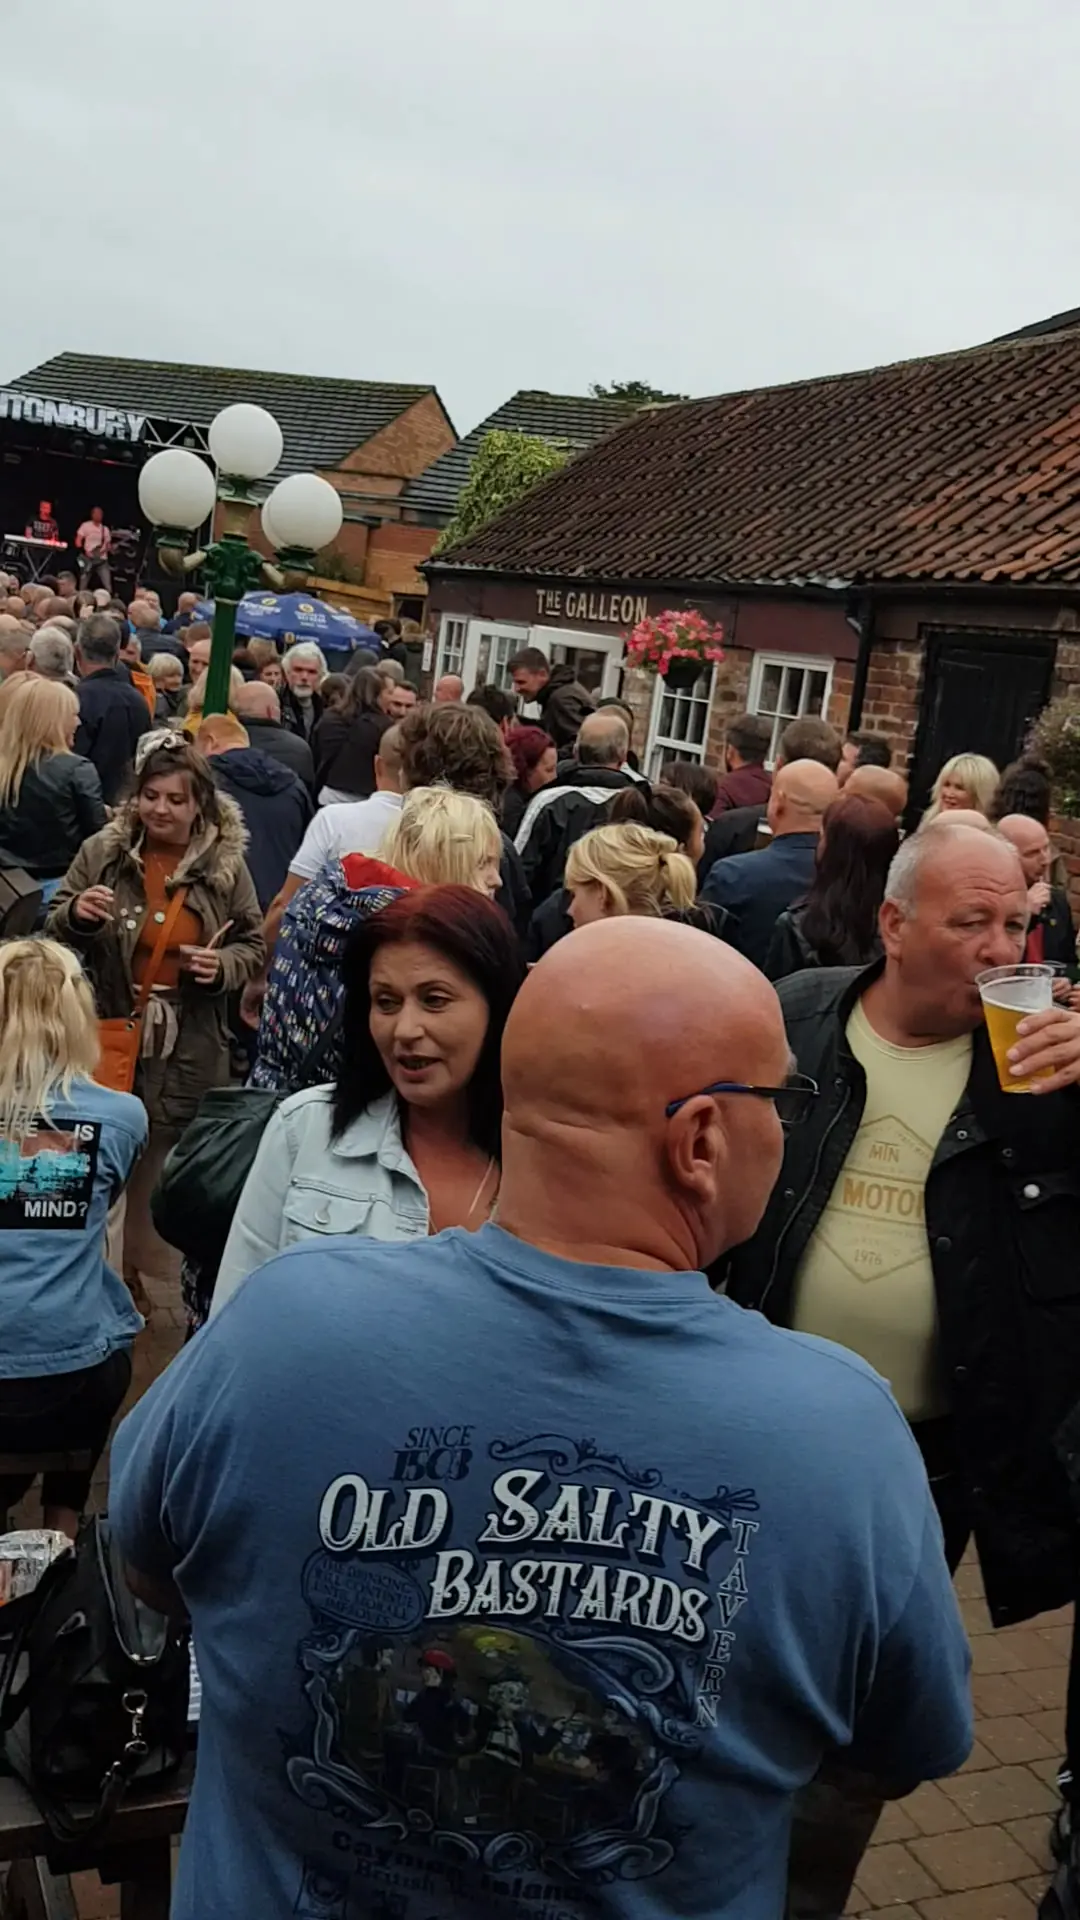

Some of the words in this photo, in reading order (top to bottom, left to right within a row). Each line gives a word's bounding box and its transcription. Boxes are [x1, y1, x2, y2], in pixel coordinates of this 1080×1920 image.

[536, 589, 562, 616] THE
[565, 591, 648, 624] GALLEON
[74, 1123, 95, 1142] IS
[24, 1200, 89, 1218] MIND?
[404, 1425, 477, 1449] SINCE
[319, 1473, 449, 1552] OLD
[478, 1468, 727, 1571] SALTY
[424, 1549, 710, 1643] BASTARDS
[695, 1517, 760, 1729] TAVERN
